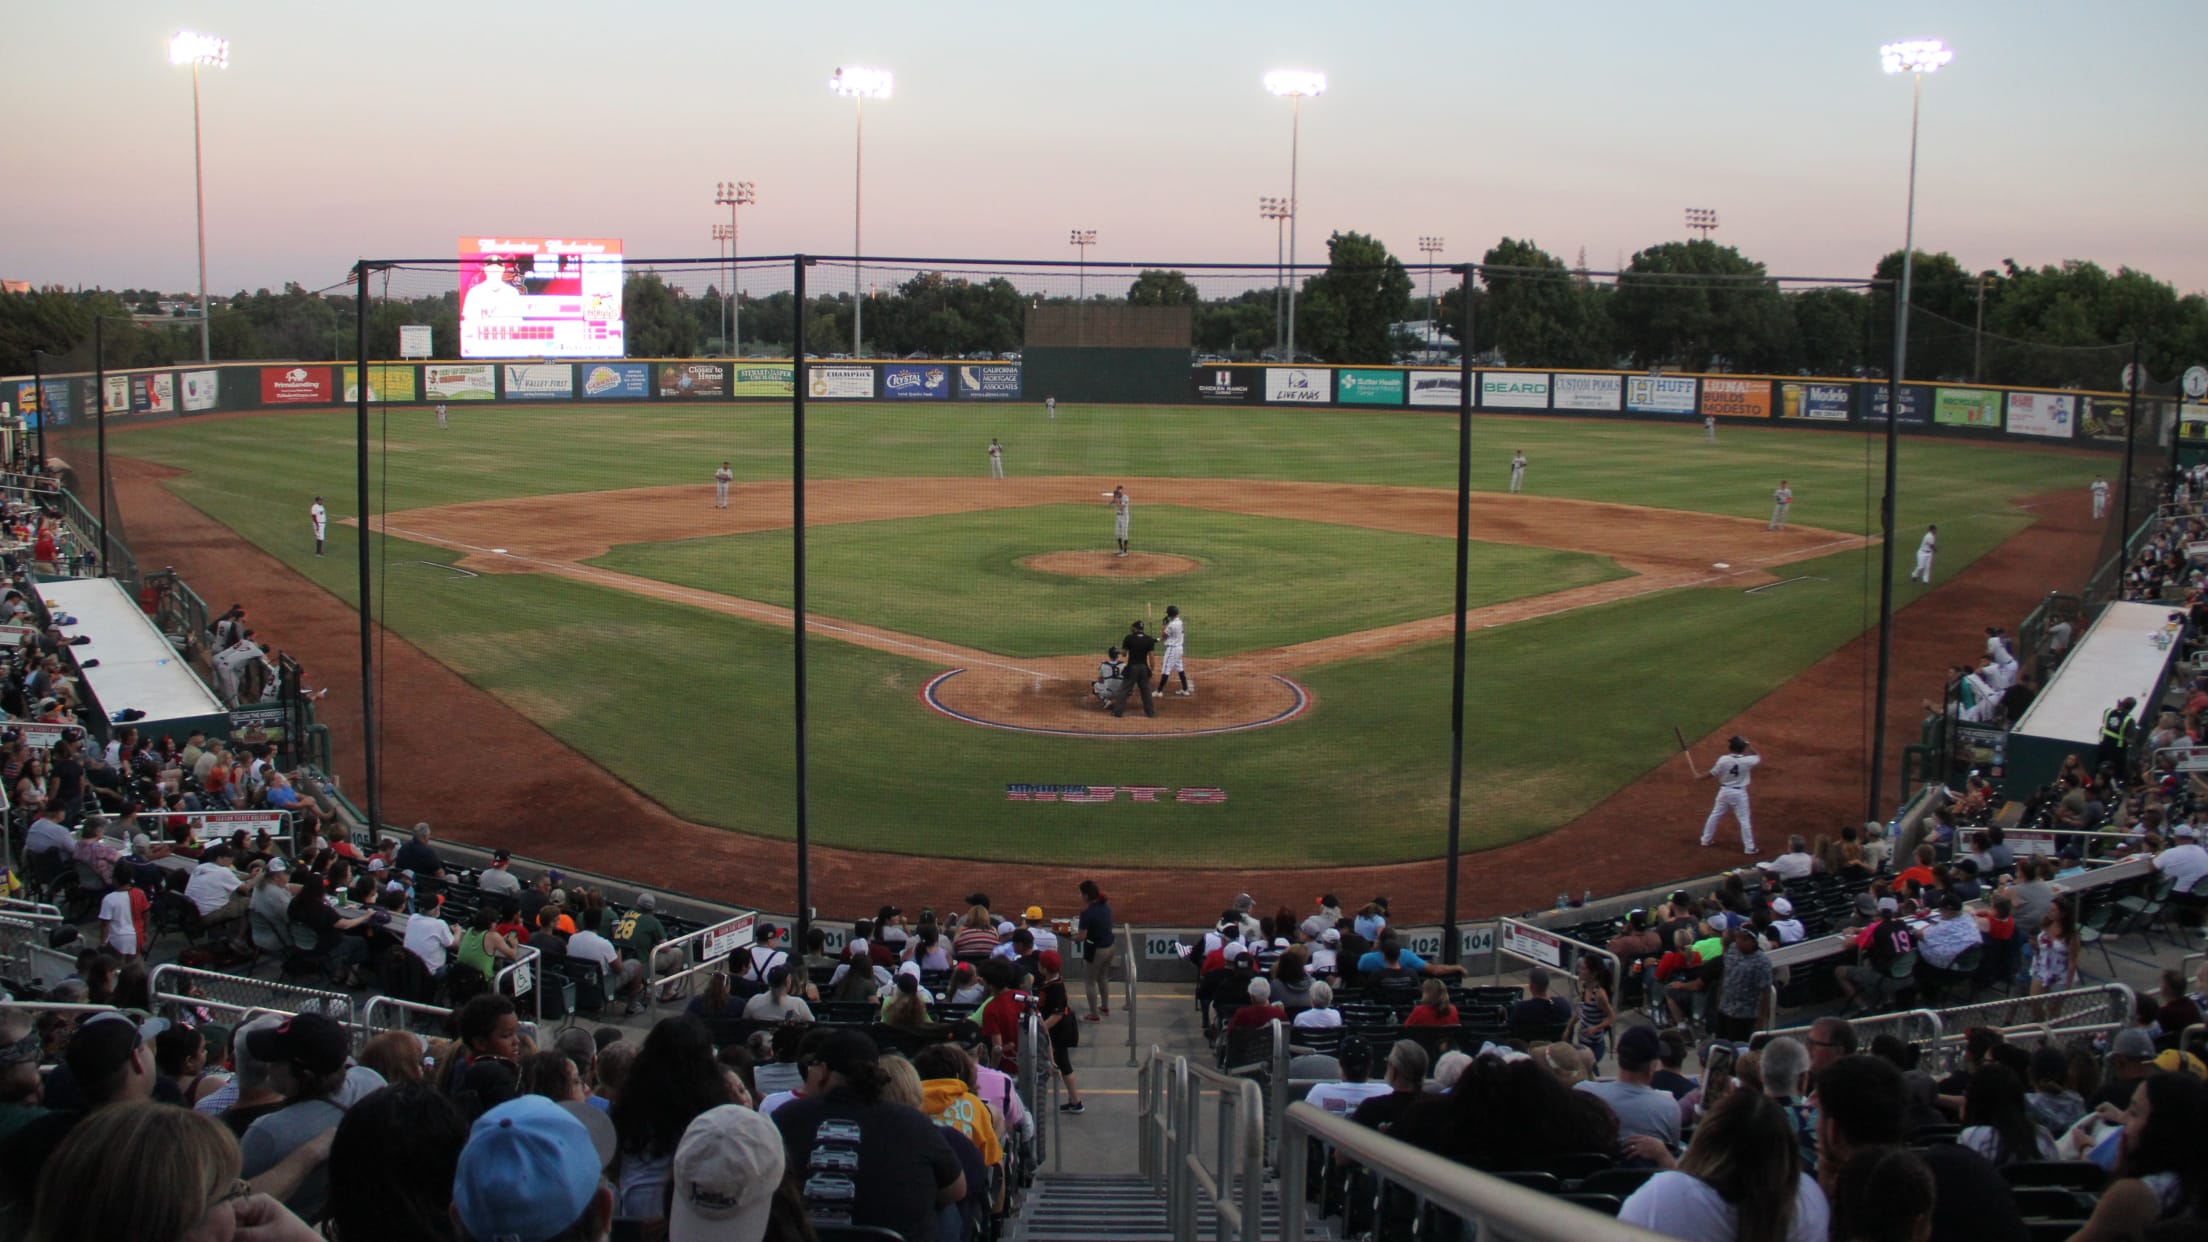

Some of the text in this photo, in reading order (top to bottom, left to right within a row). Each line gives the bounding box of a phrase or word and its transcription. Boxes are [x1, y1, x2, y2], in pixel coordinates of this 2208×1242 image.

[886, 373, 921, 388] CRYSTAL
[983, 374, 1017, 382] MORTGAGE
[1484, 382, 1547, 394] BEARD
[1556, 379, 1590, 391] CUSTOM
[1656, 380, 1695, 393] HUFF
[1276, 391, 1297, 400] LIVE
[1703, 391, 1745, 403] BUILDS
[1809, 386, 1849, 403] Modelo
[1703, 403, 1762, 415] MODESTO
[1729, 764, 1739, 777] 4
[1147, 939, 1178, 954] 102
[1411, 937, 1440, 953] 102
[1463, 933, 1491, 950] 104
[1891, 930, 1911, 953] 19
